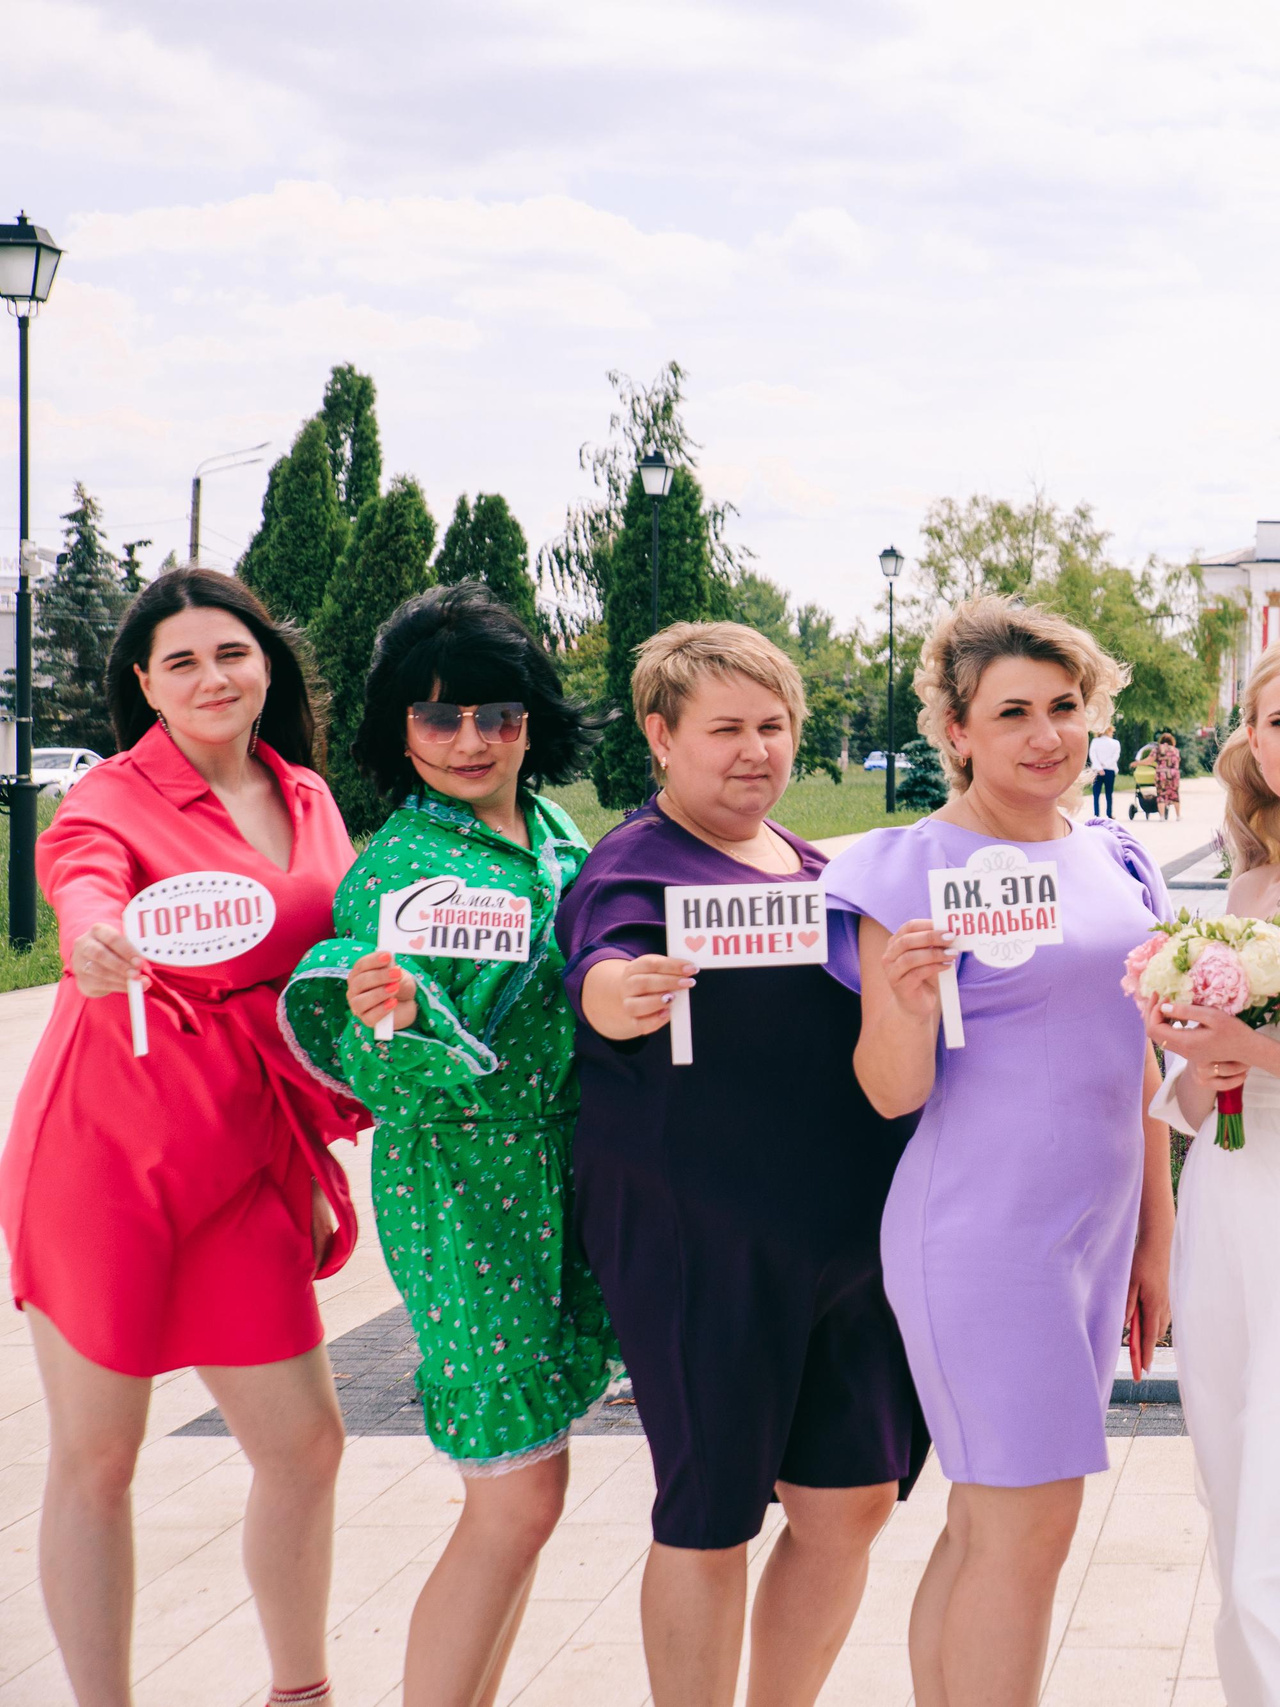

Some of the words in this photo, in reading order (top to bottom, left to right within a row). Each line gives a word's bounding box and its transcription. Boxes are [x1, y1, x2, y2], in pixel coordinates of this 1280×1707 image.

[395, 880, 506, 932] Самая
[943, 879, 992, 909] АХ,
[1000, 874, 1057, 905] ЭТА
[137, 896, 263, 938] ГОРЬКО!
[683, 891, 820, 929] НАЛЕЙТЕ
[947, 906, 1057, 936] СВАДЬБА!
[431, 925, 524, 953] ПАРА!
[712, 932, 794, 956] МНЕ!
